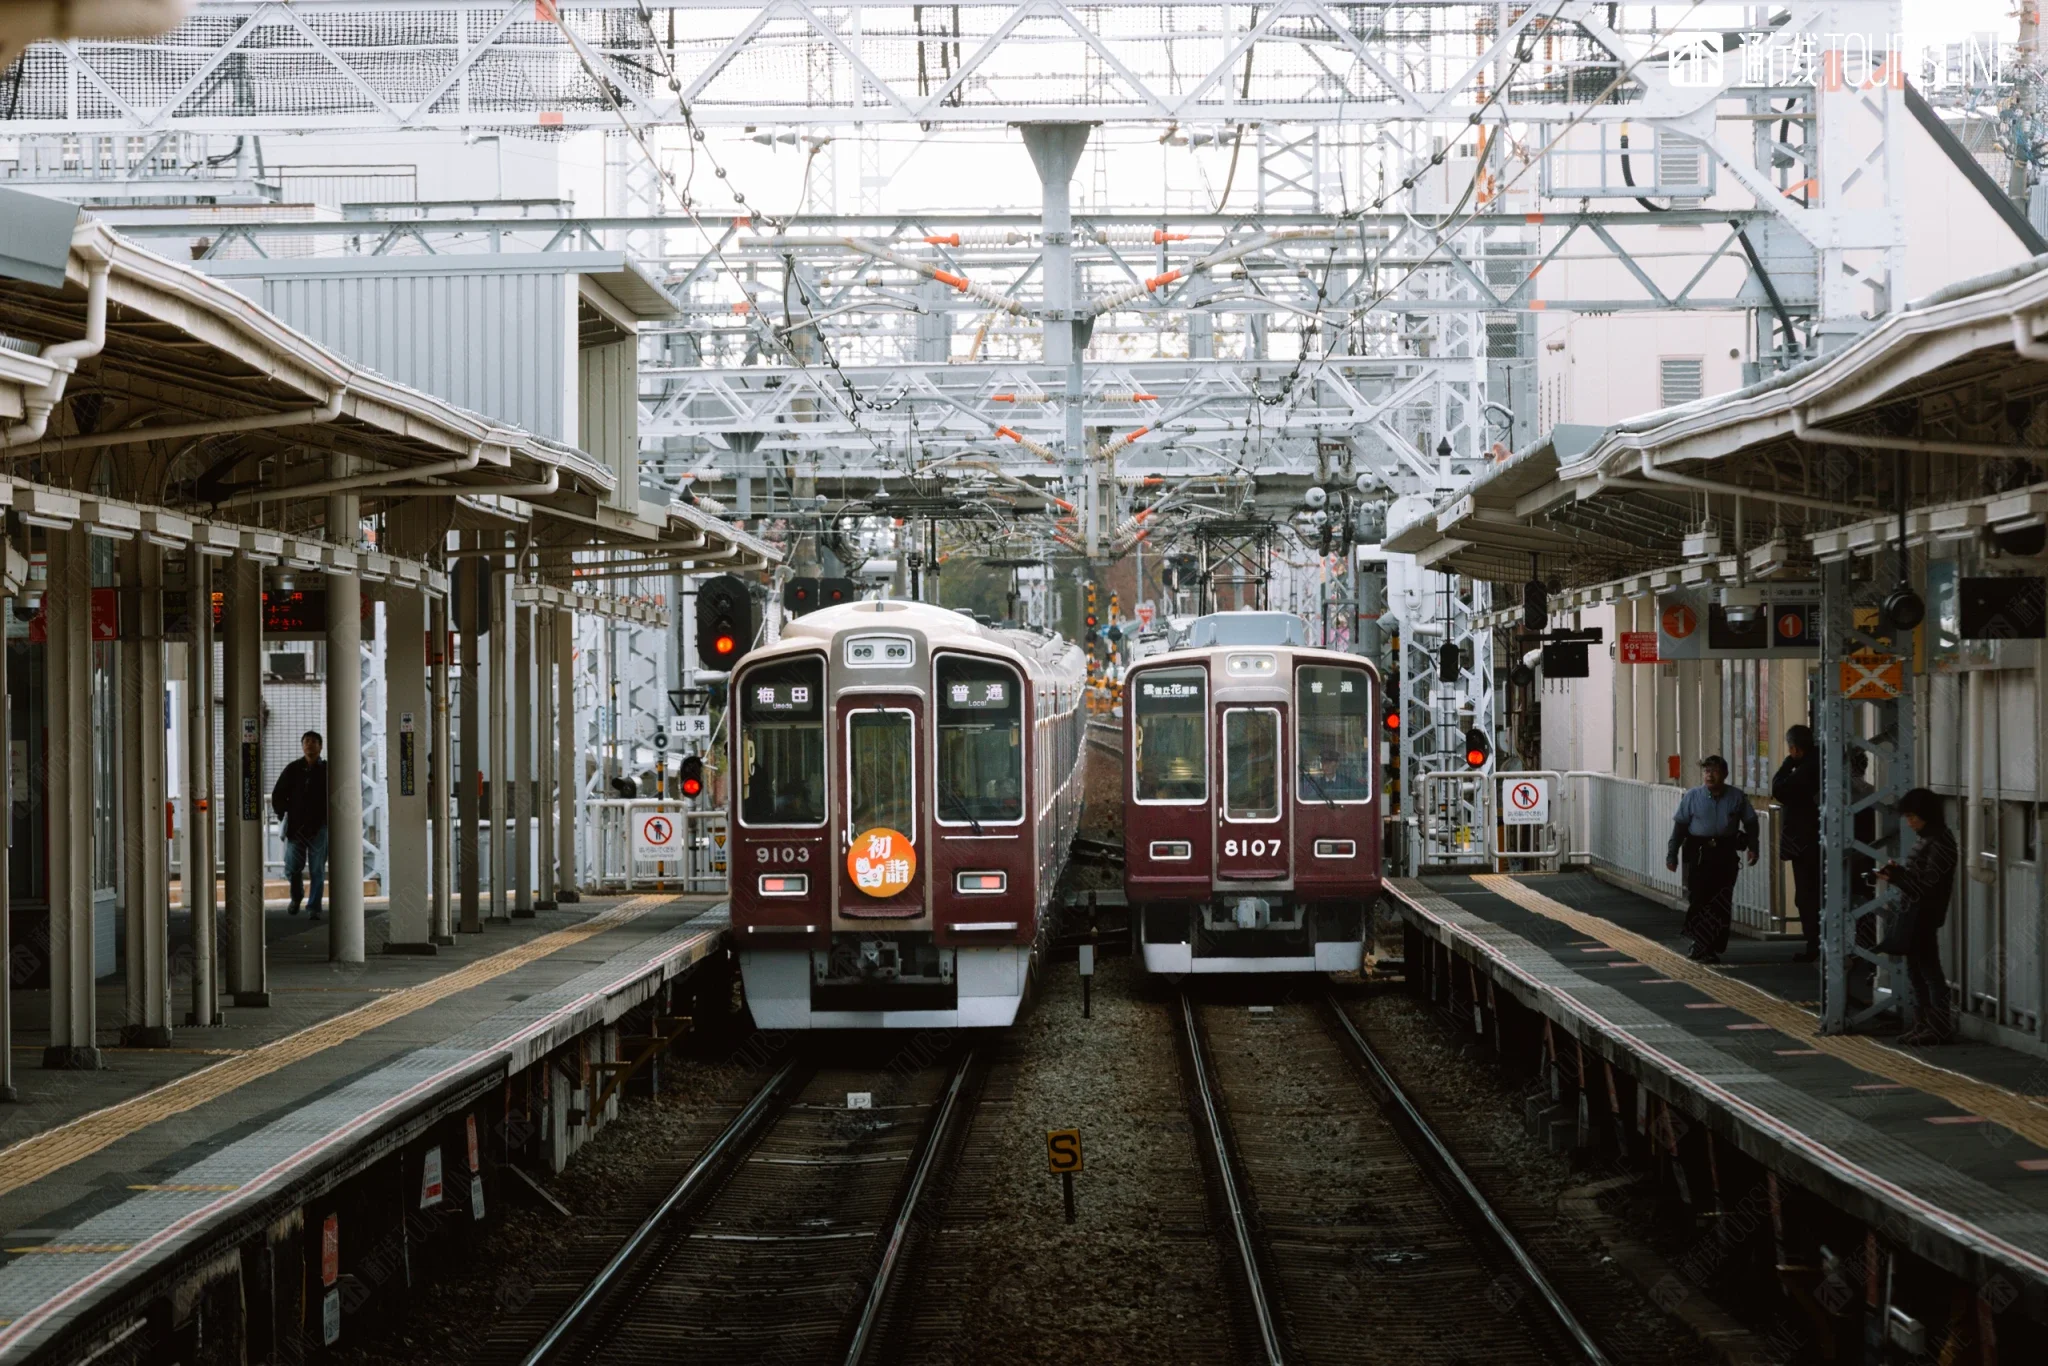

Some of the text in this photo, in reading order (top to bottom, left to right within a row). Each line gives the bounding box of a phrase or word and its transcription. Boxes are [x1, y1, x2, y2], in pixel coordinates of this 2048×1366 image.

[1673, 608, 1685, 634] 1
[1783, 616, 1793, 636] 1
[756, 686, 809, 704] 梅田
[951, 683, 1005, 703] 普通
[1310, 681, 1354, 694] 普通
[675, 719, 706, 732] 出発
[756, 847, 810, 864] 9103
[1224, 839, 1282, 857] 8107
[1049, 1134, 1078, 1168] S
